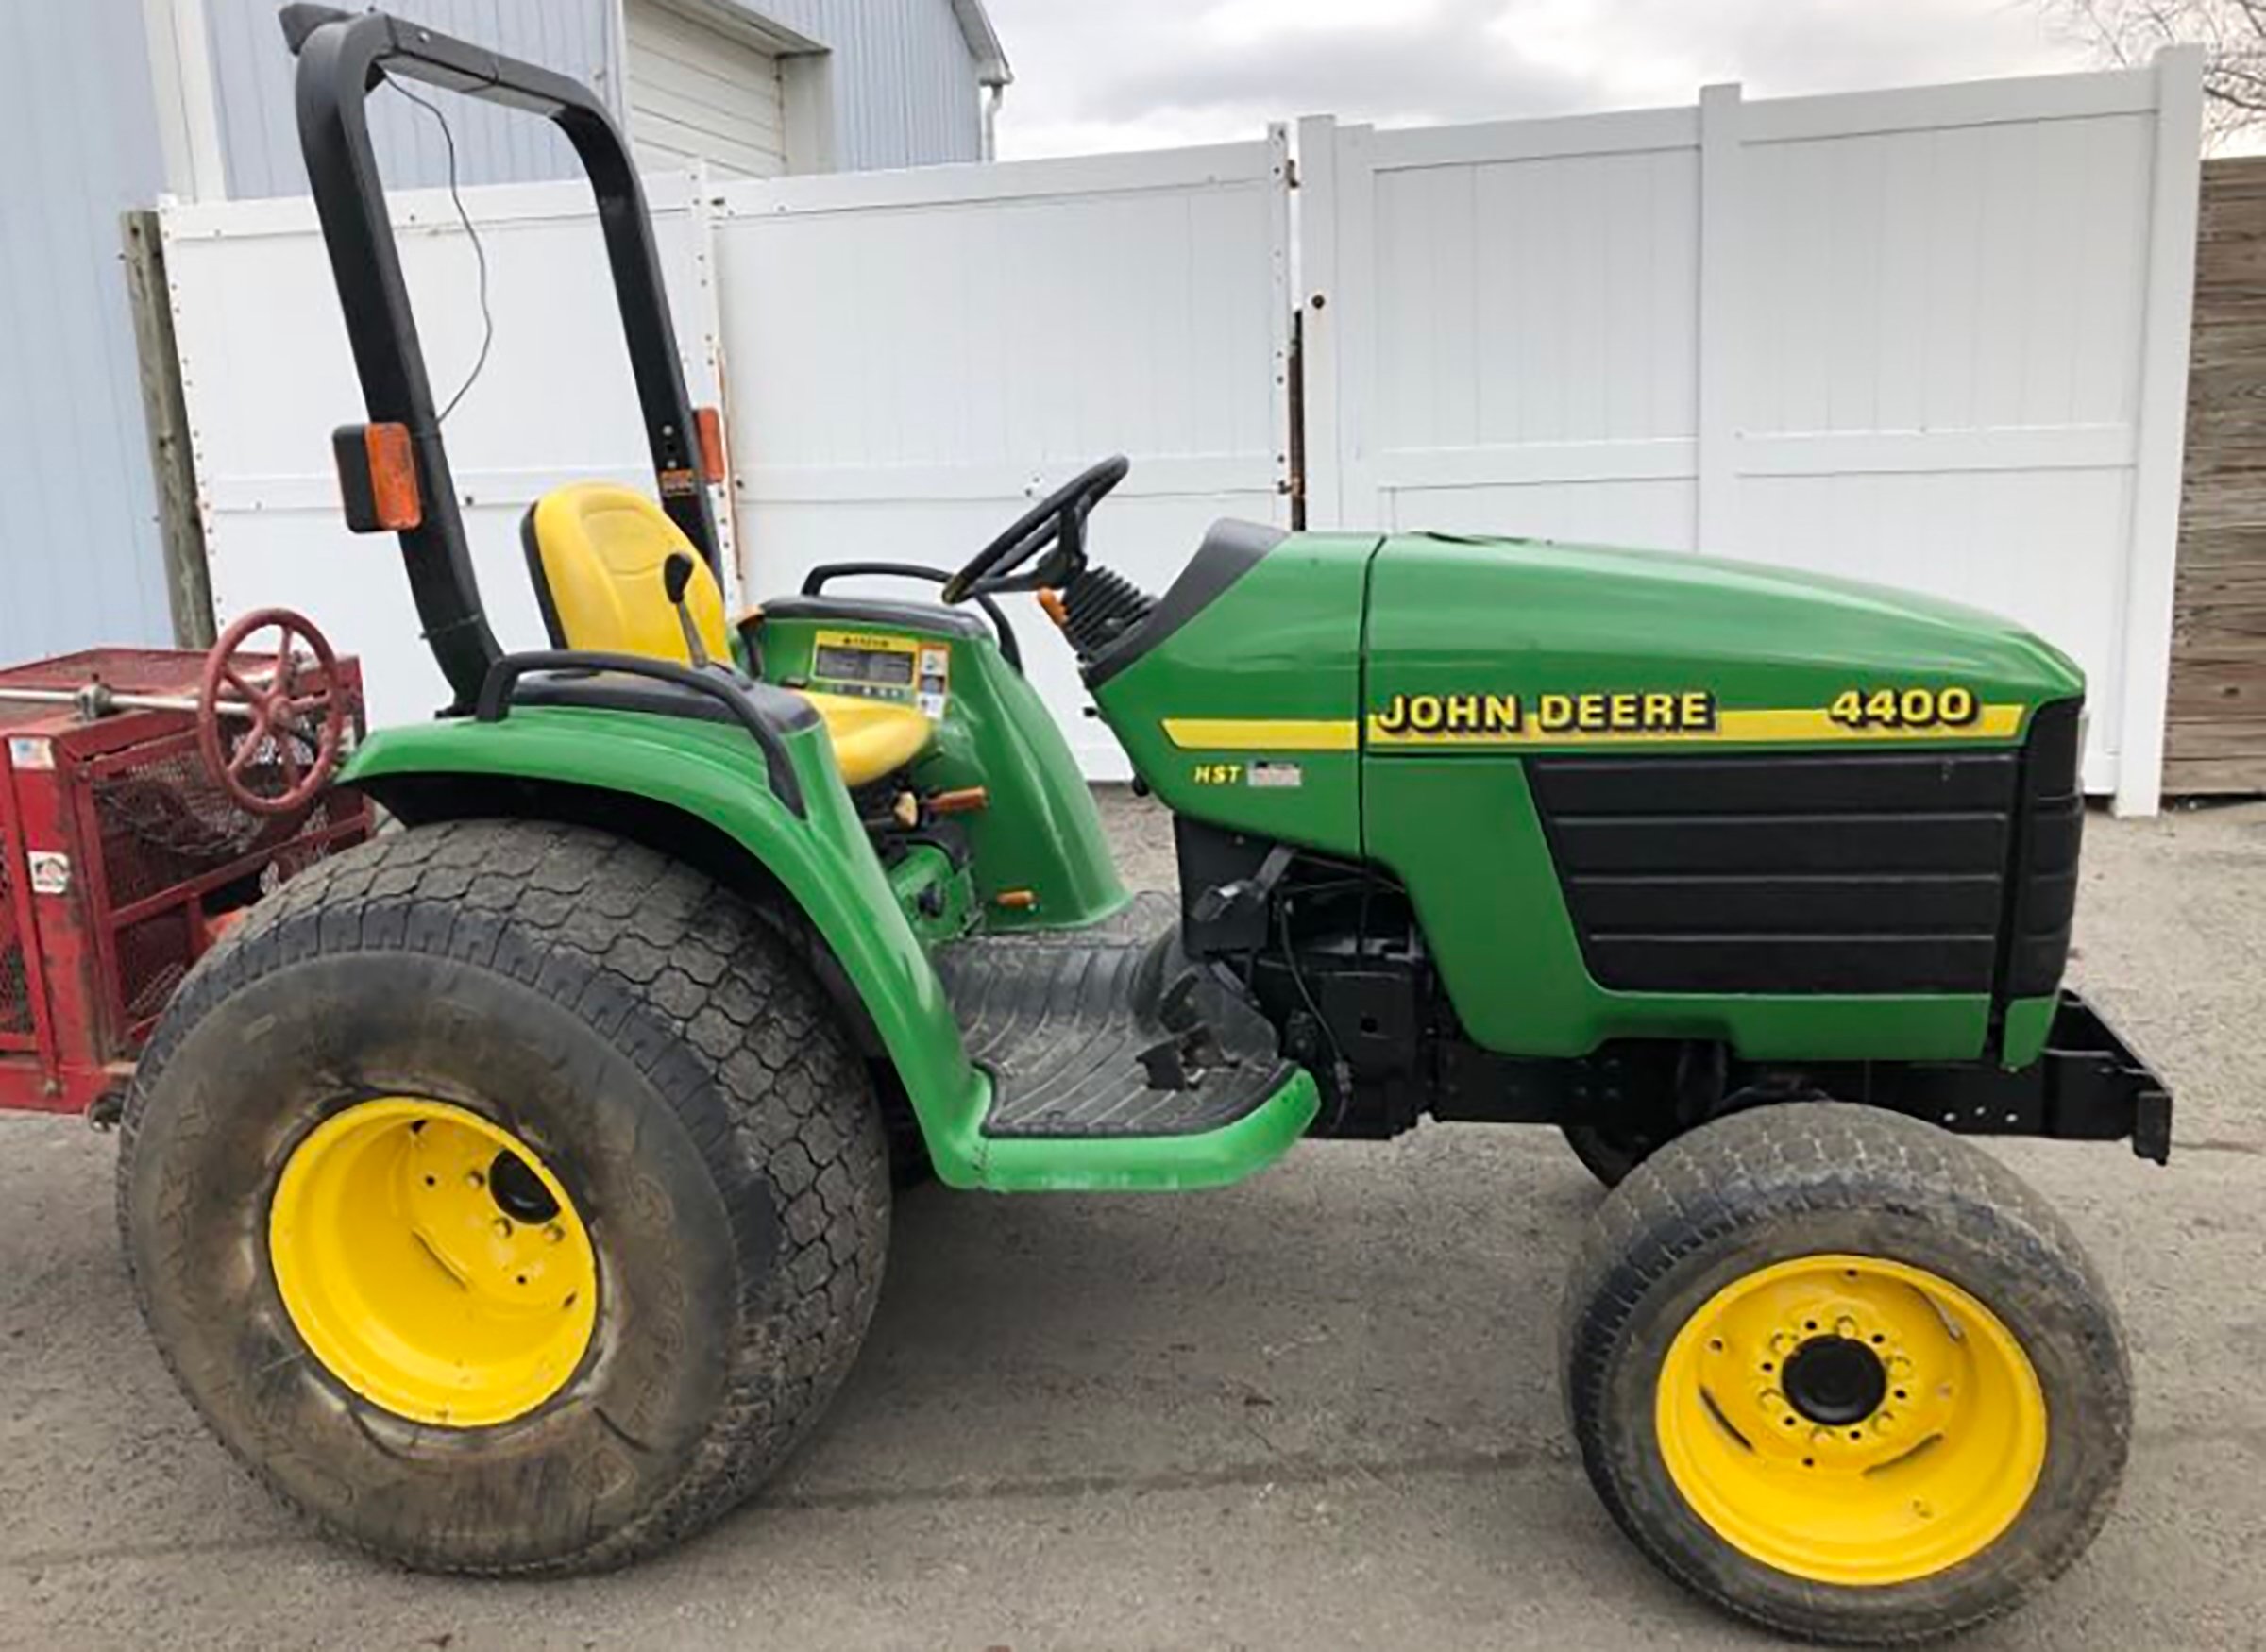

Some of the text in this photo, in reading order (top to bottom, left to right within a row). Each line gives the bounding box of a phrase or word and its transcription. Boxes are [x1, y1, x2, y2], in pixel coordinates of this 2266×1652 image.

[1378, 692, 1715, 731] JOHN DEERE
[1828, 687, 1978, 726] 4400
[1194, 764, 1243, 784] HST
